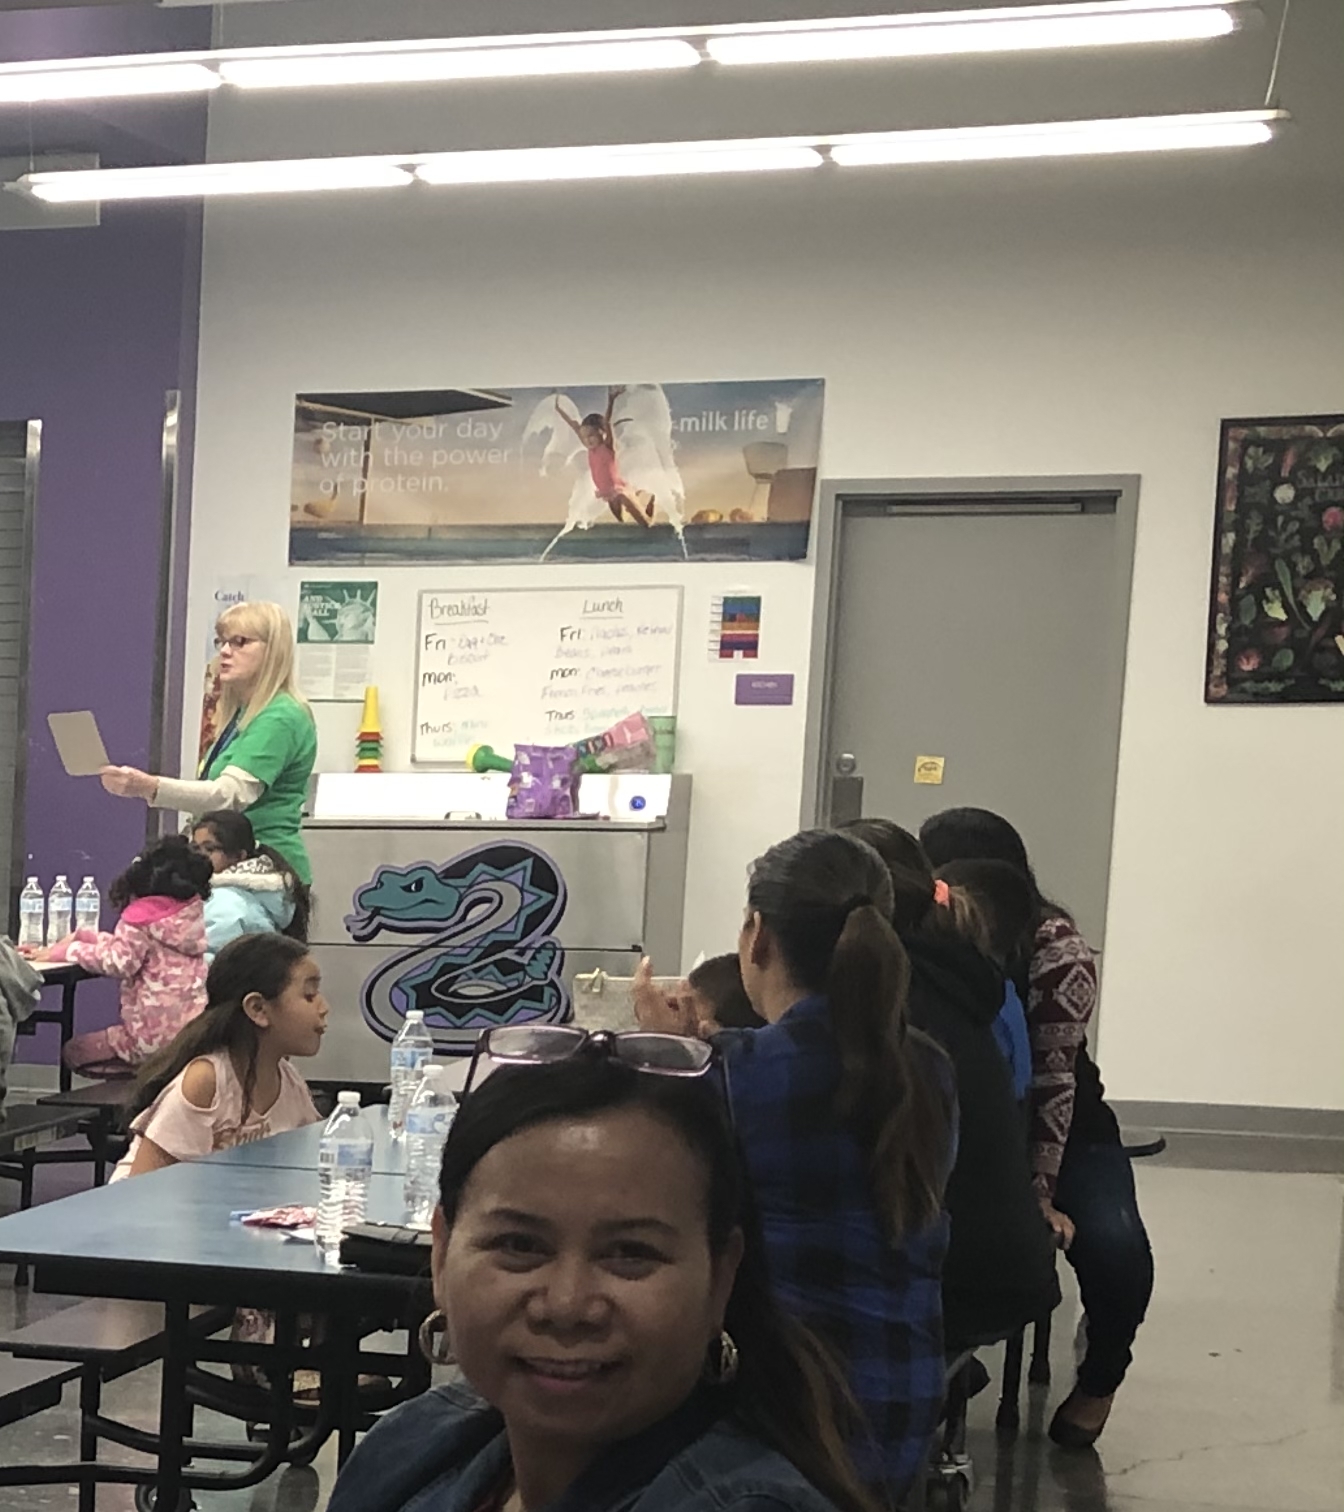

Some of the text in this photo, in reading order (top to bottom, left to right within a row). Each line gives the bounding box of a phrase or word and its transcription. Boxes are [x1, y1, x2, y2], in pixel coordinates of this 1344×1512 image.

[321, 418, 503, 443] Start your day
[680, 410, 769, 432] milk life
[321, 447, 511, 468] with the power
[319, 473, 448, 496] of protein.
[428, 596, 490, 619] Breakfast
[582, 597, 623, 614] Lunch
